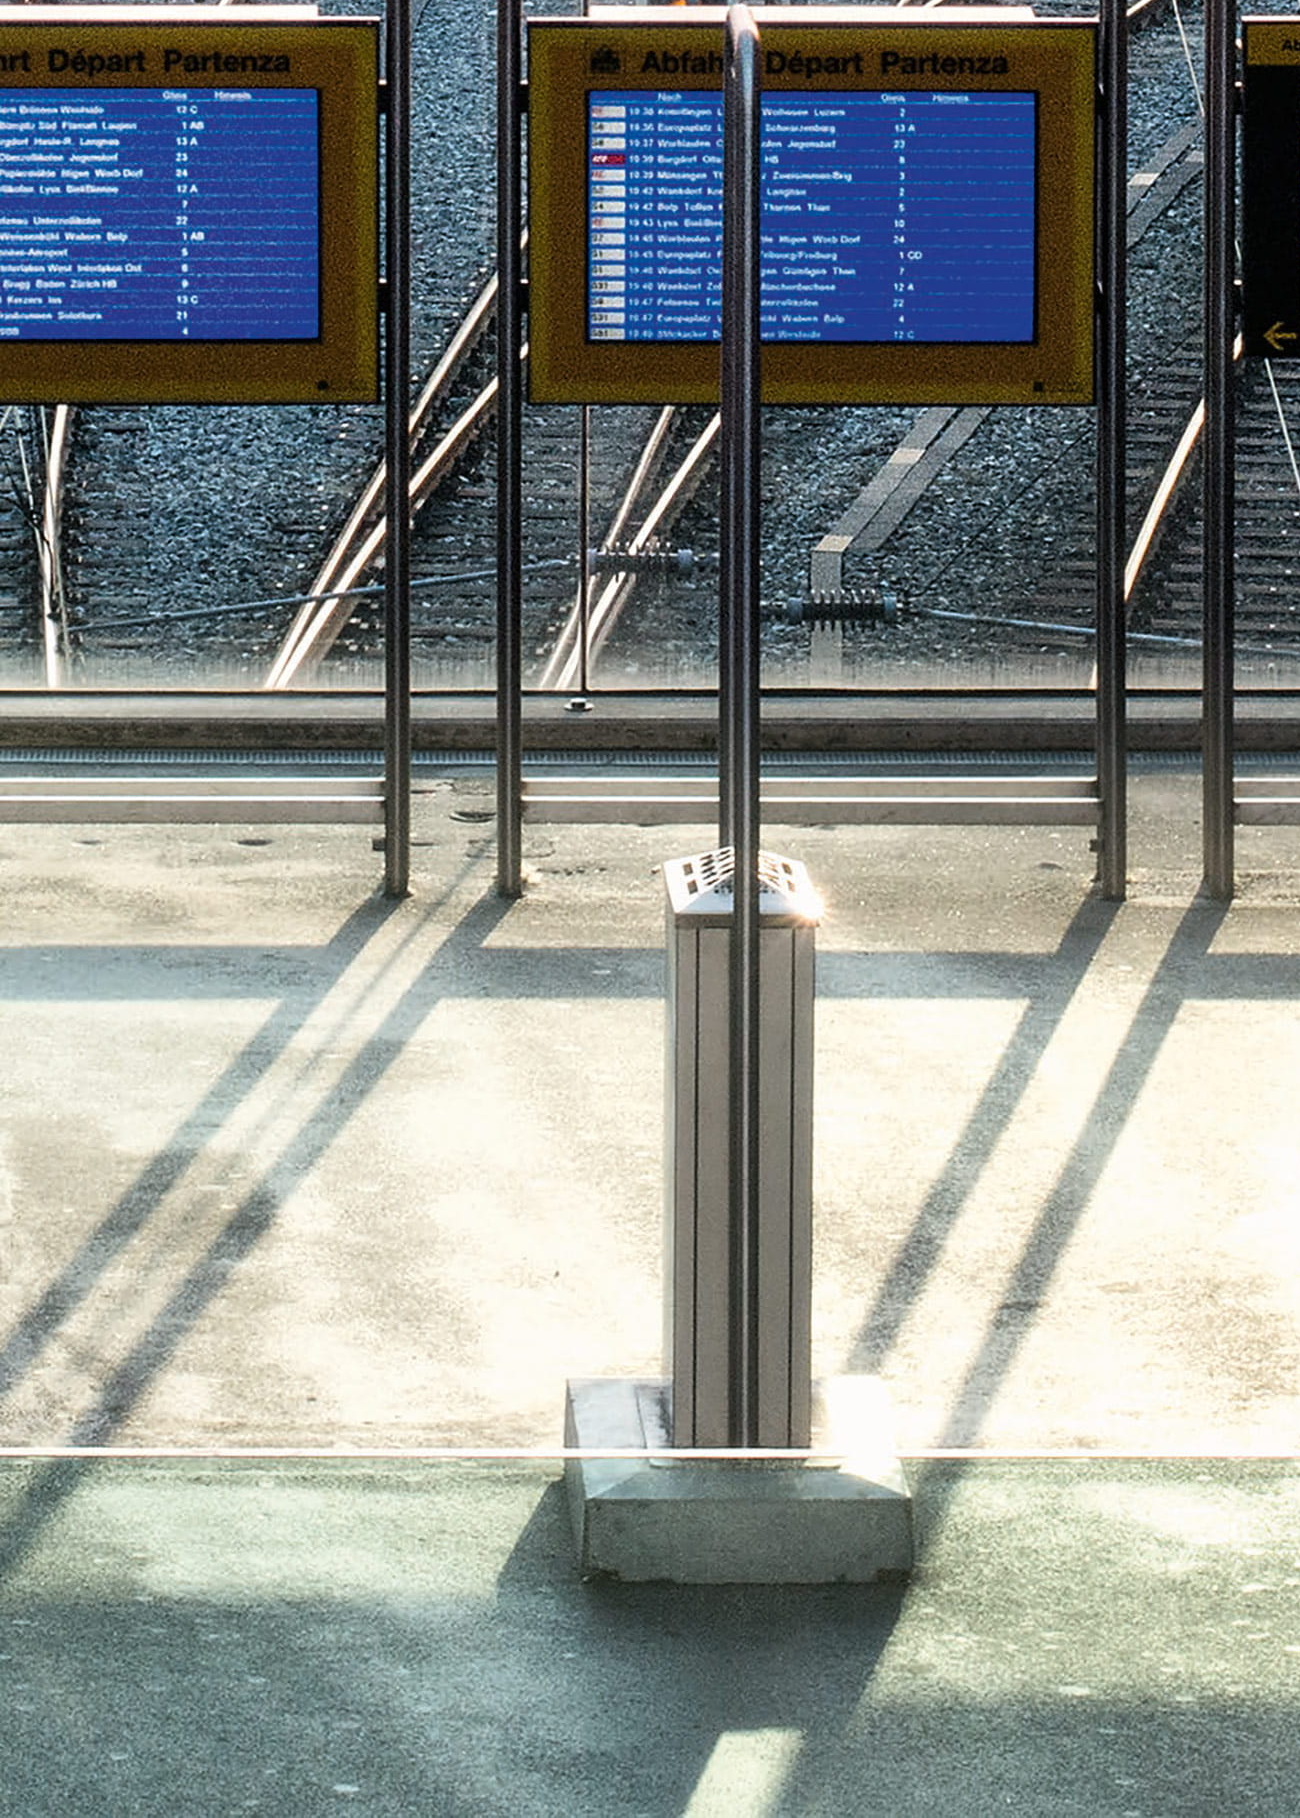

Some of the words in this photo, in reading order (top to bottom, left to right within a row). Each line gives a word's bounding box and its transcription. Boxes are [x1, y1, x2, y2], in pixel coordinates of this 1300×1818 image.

[48, 47, 145, 76] Départ
[163, 49, 290, 73] Partenza
[640, 50, 722, 74] Abfah
[764, 51, 864, 79] Départ
[880, 51, 1009, 75] Partenza
